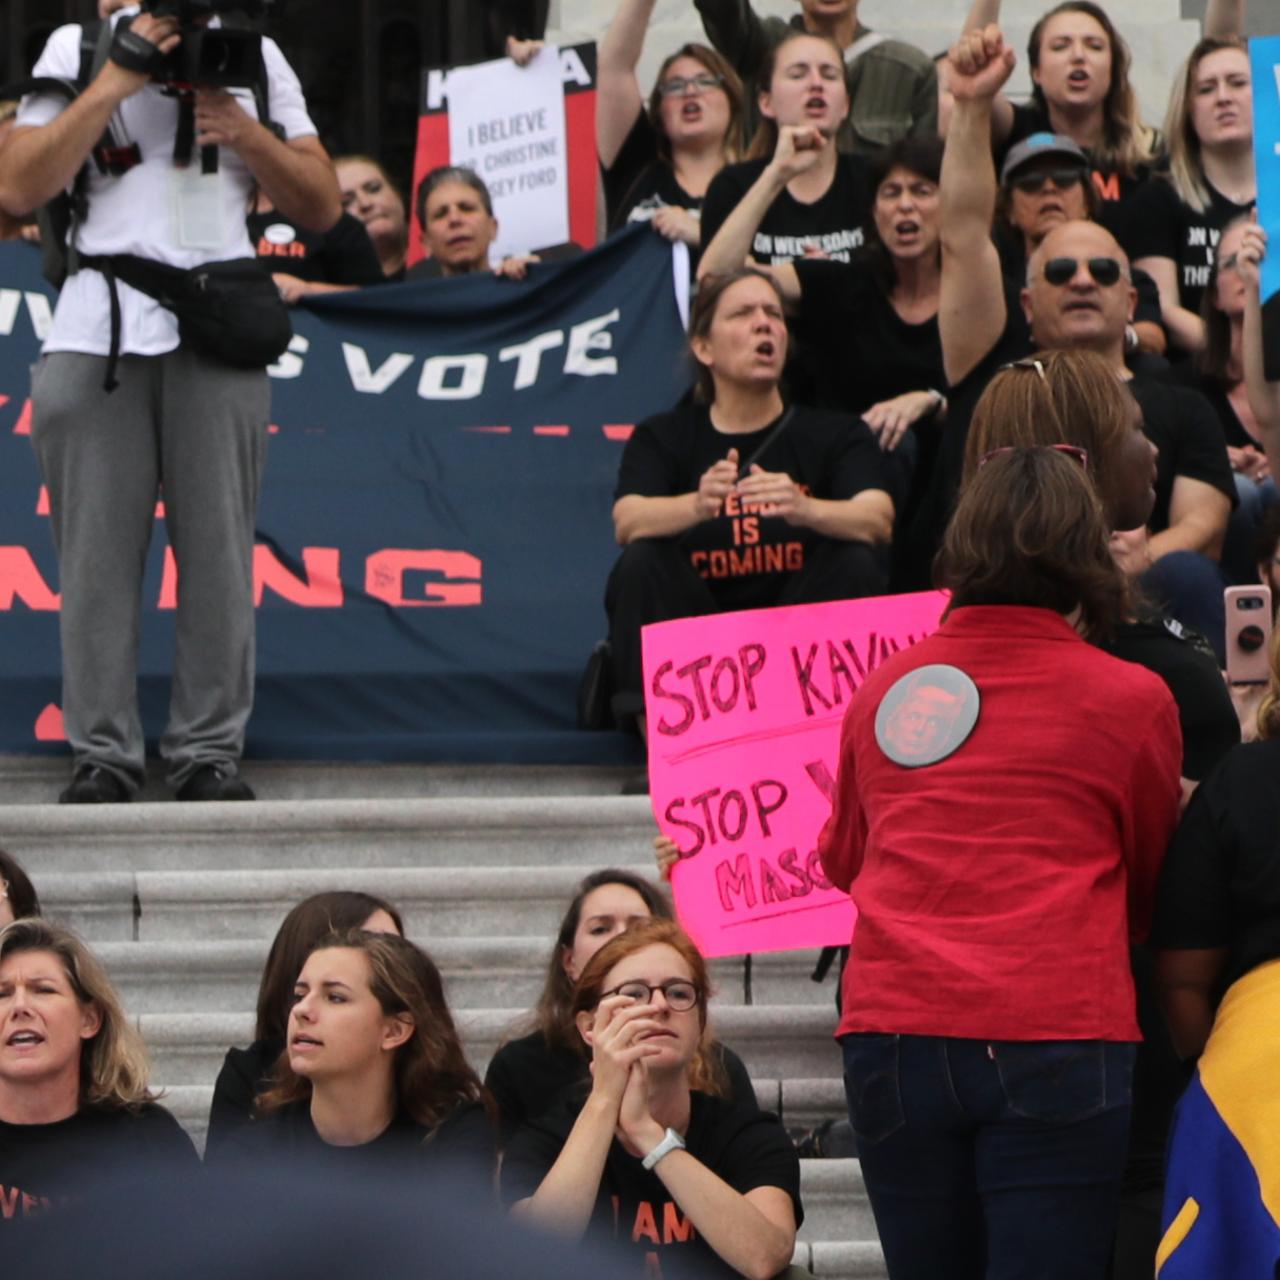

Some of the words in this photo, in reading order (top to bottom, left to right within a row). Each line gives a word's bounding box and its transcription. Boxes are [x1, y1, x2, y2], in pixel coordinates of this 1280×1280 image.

[427, 47, 592, 110] KA
[478, 108, 547, 145] BELIEVE
[484, 137, 558, 172] CHRISTINE
[490, 175, 516, 200] SEY
[518, 168, 557, 196] FORD
[258, 236, 306, 258] BER
[341, 309, 621, 400] VOTE
[732, 516, 760, 546] IS
[691, 541, 804, 579] COMING
[652, 642, 767, 736] STOP
[780, 632, 942, 717] KAV
[664, 779, 789, 860] STOP
[714, 847, 842, 913] MASC
